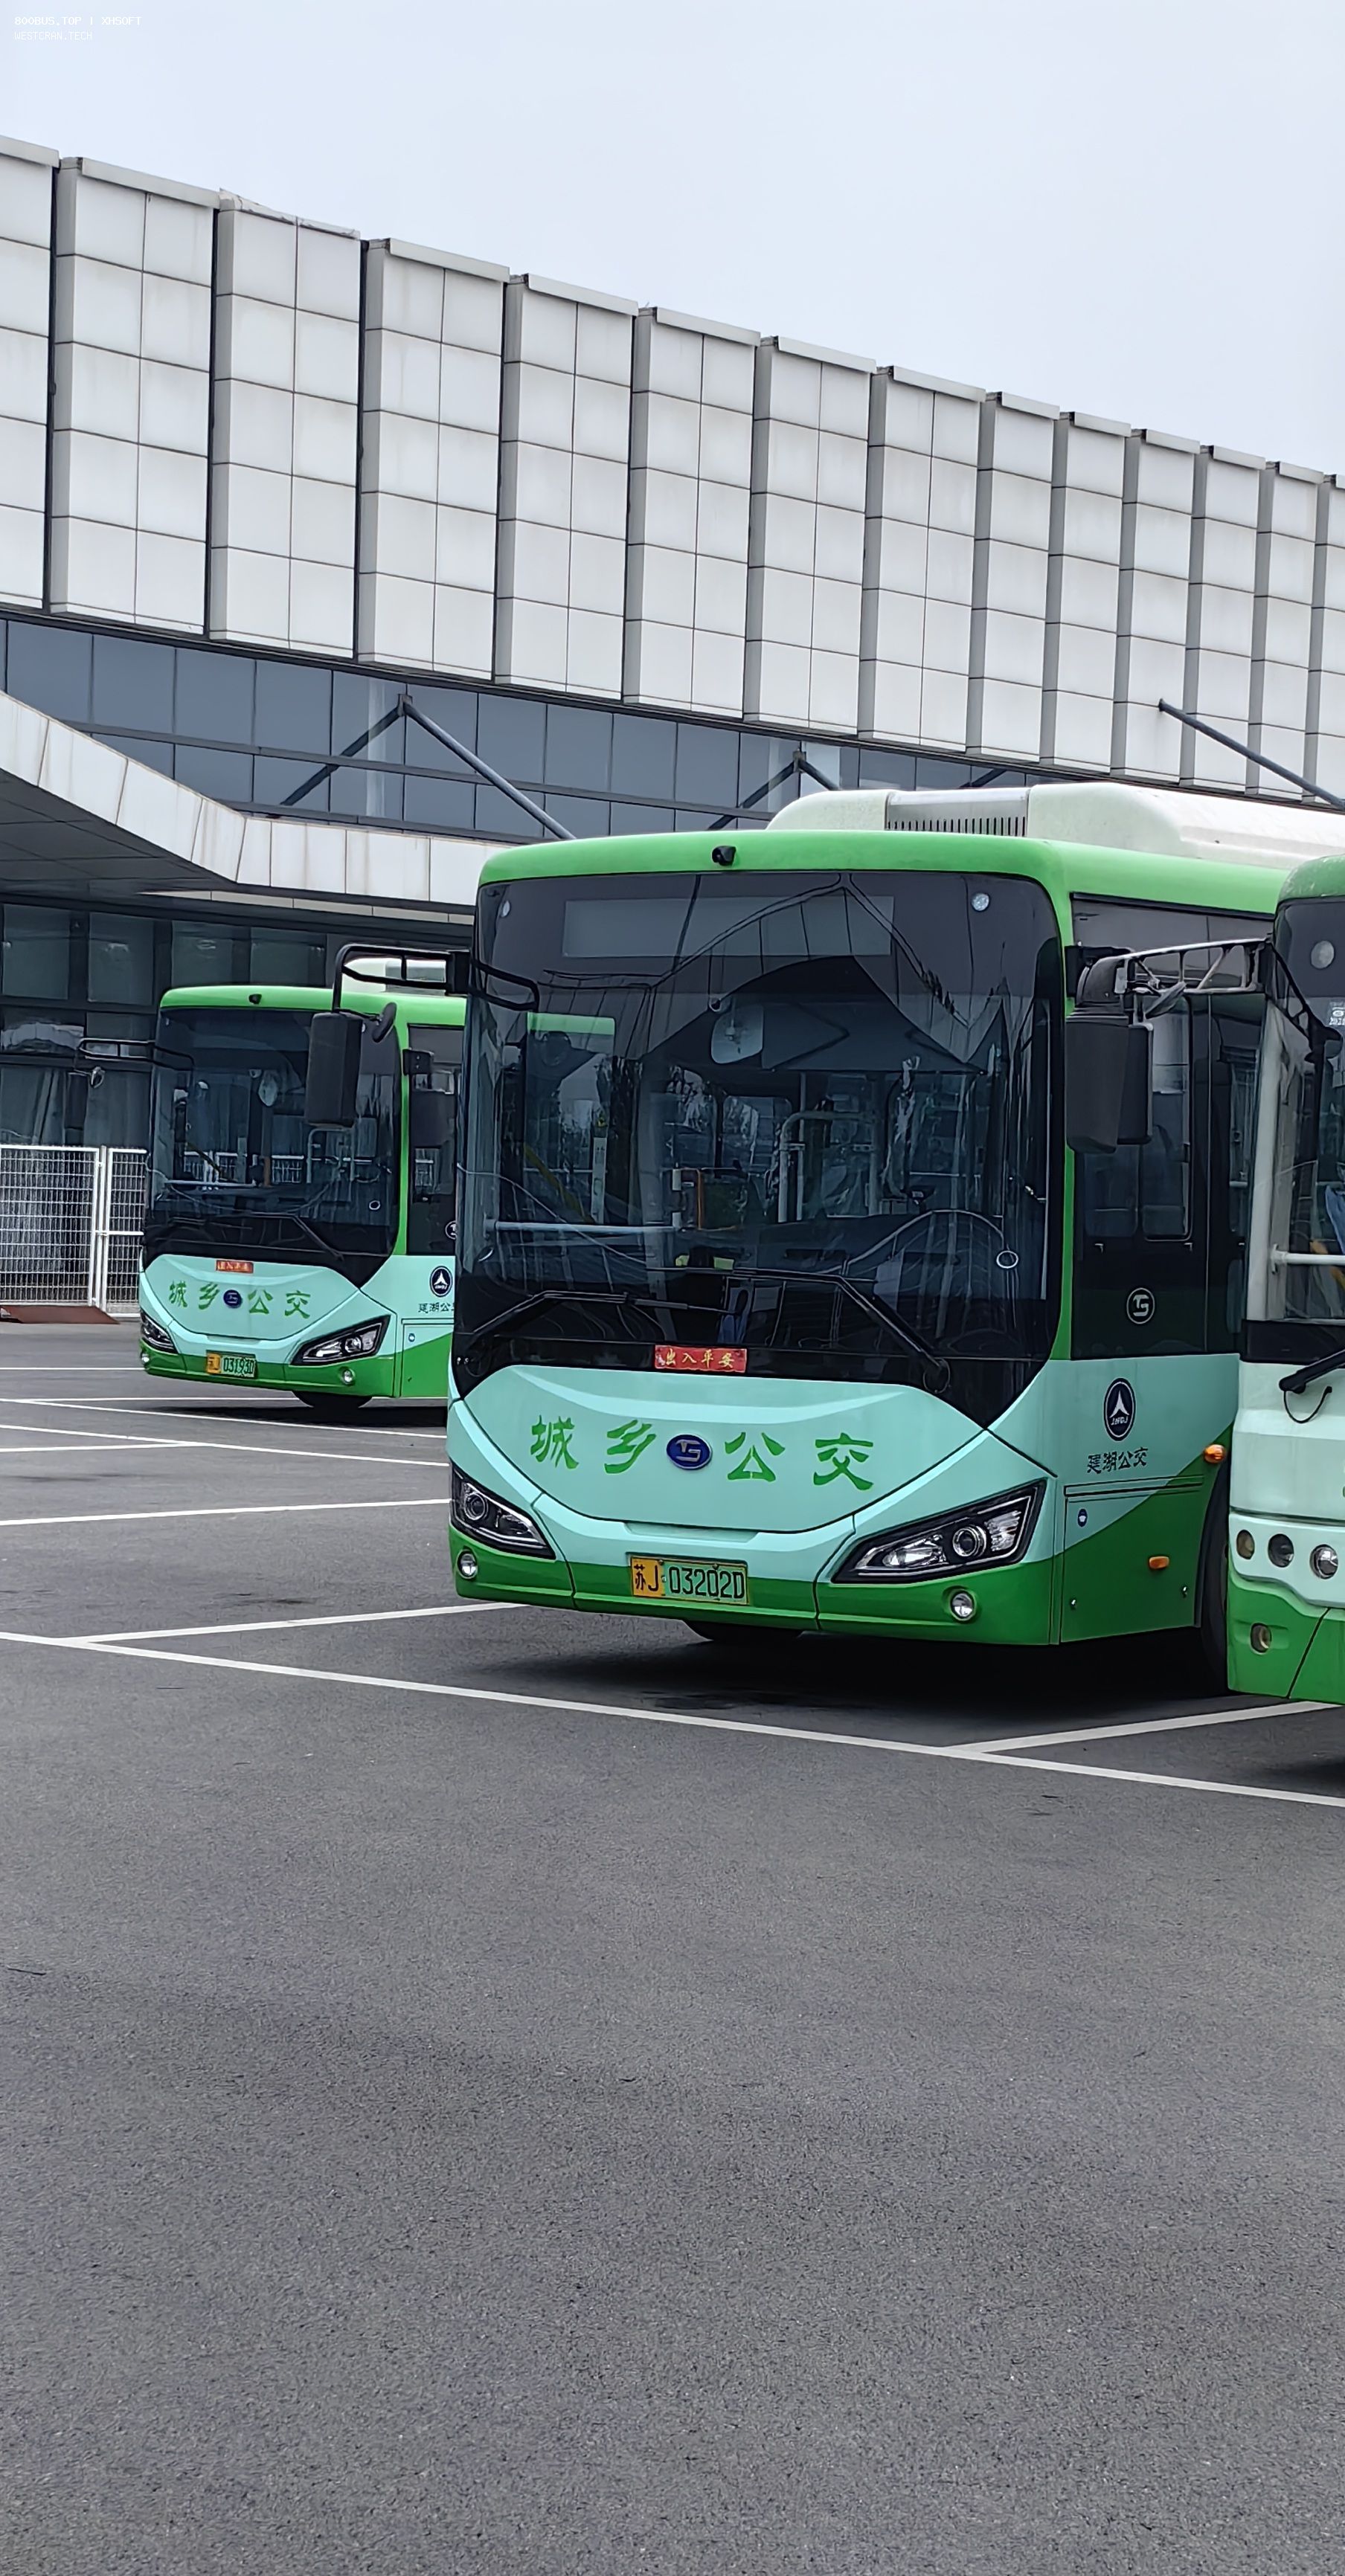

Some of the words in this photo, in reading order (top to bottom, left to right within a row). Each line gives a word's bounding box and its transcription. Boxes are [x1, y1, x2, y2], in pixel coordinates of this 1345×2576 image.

[666, 1348, 734, 1368] 出入平安
[530, 1414, 874, 1490] 城乡公交
